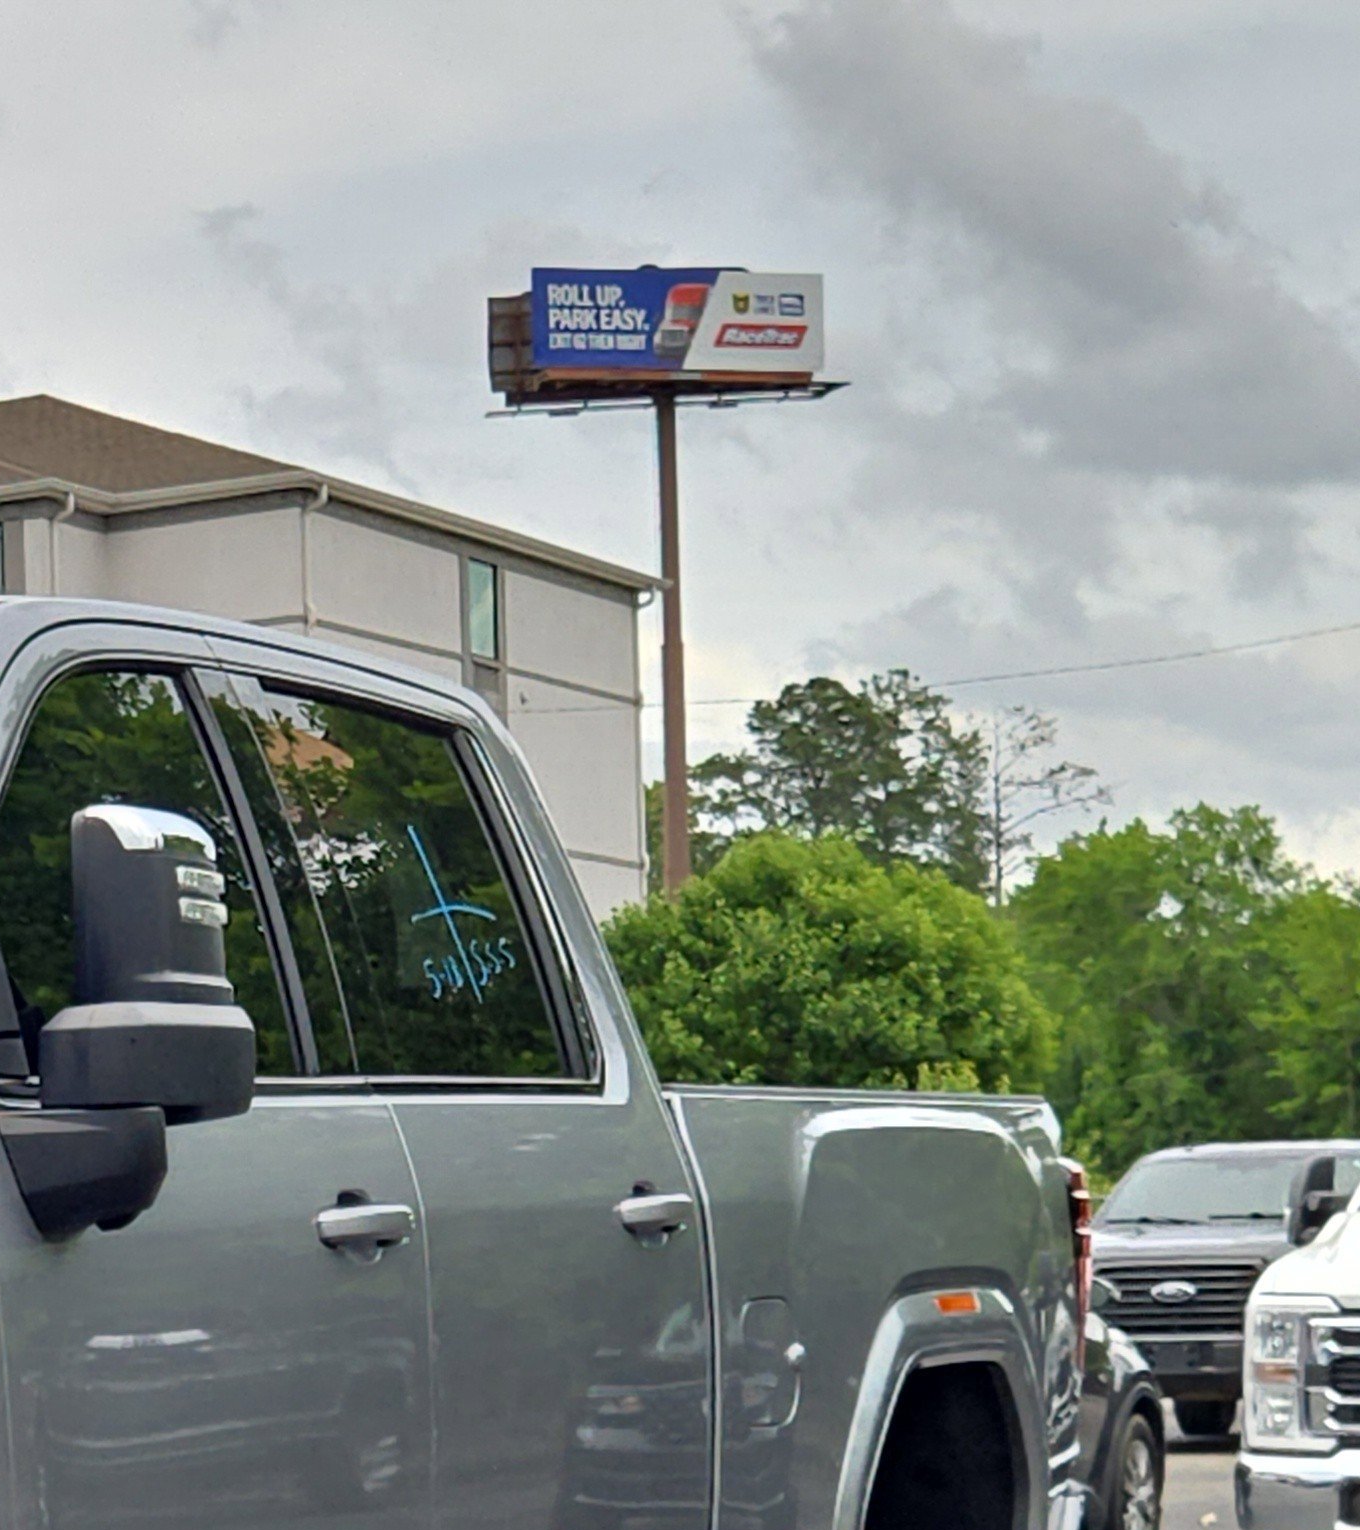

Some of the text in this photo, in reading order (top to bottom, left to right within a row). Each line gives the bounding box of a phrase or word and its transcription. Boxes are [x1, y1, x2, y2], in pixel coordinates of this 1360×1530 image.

[547, 284, 594, 307] ROLL
[548, 308, 650, 331] PARK EASY.
